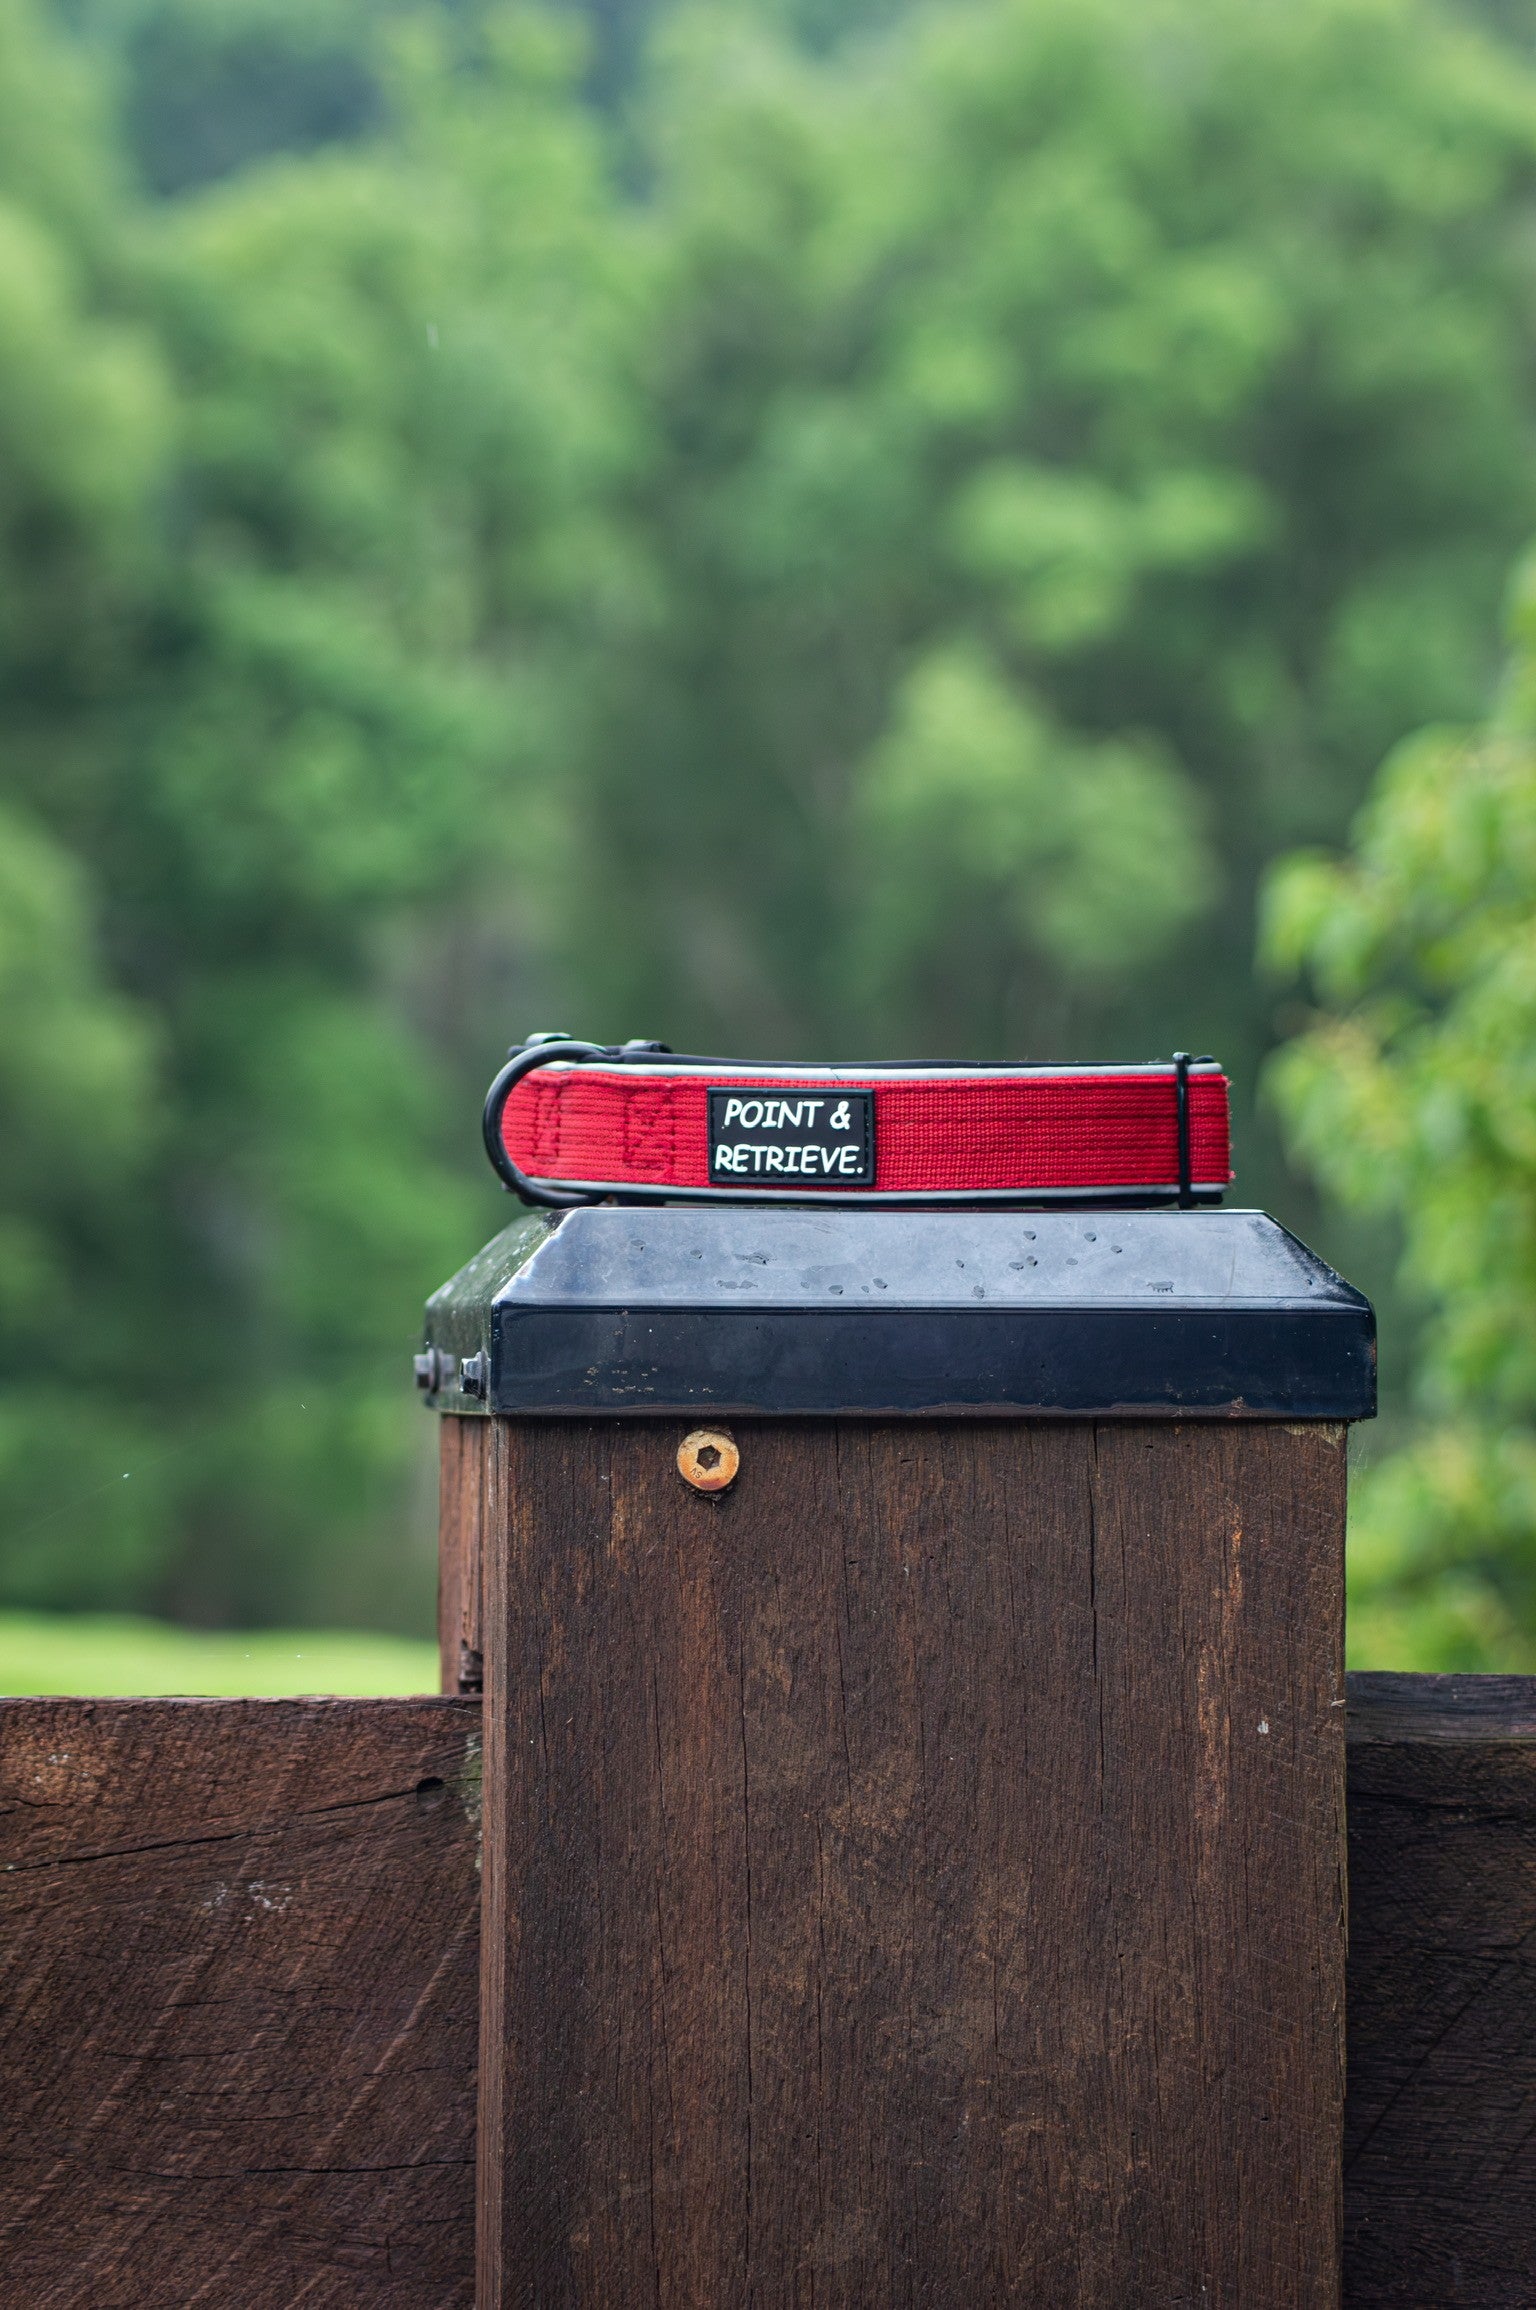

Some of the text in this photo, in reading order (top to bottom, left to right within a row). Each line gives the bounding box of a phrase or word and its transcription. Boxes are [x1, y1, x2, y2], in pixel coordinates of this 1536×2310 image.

[724, 1099, 851, 1130] POINT &
[714, 1144, 864, 1174] RETRIEVE.
